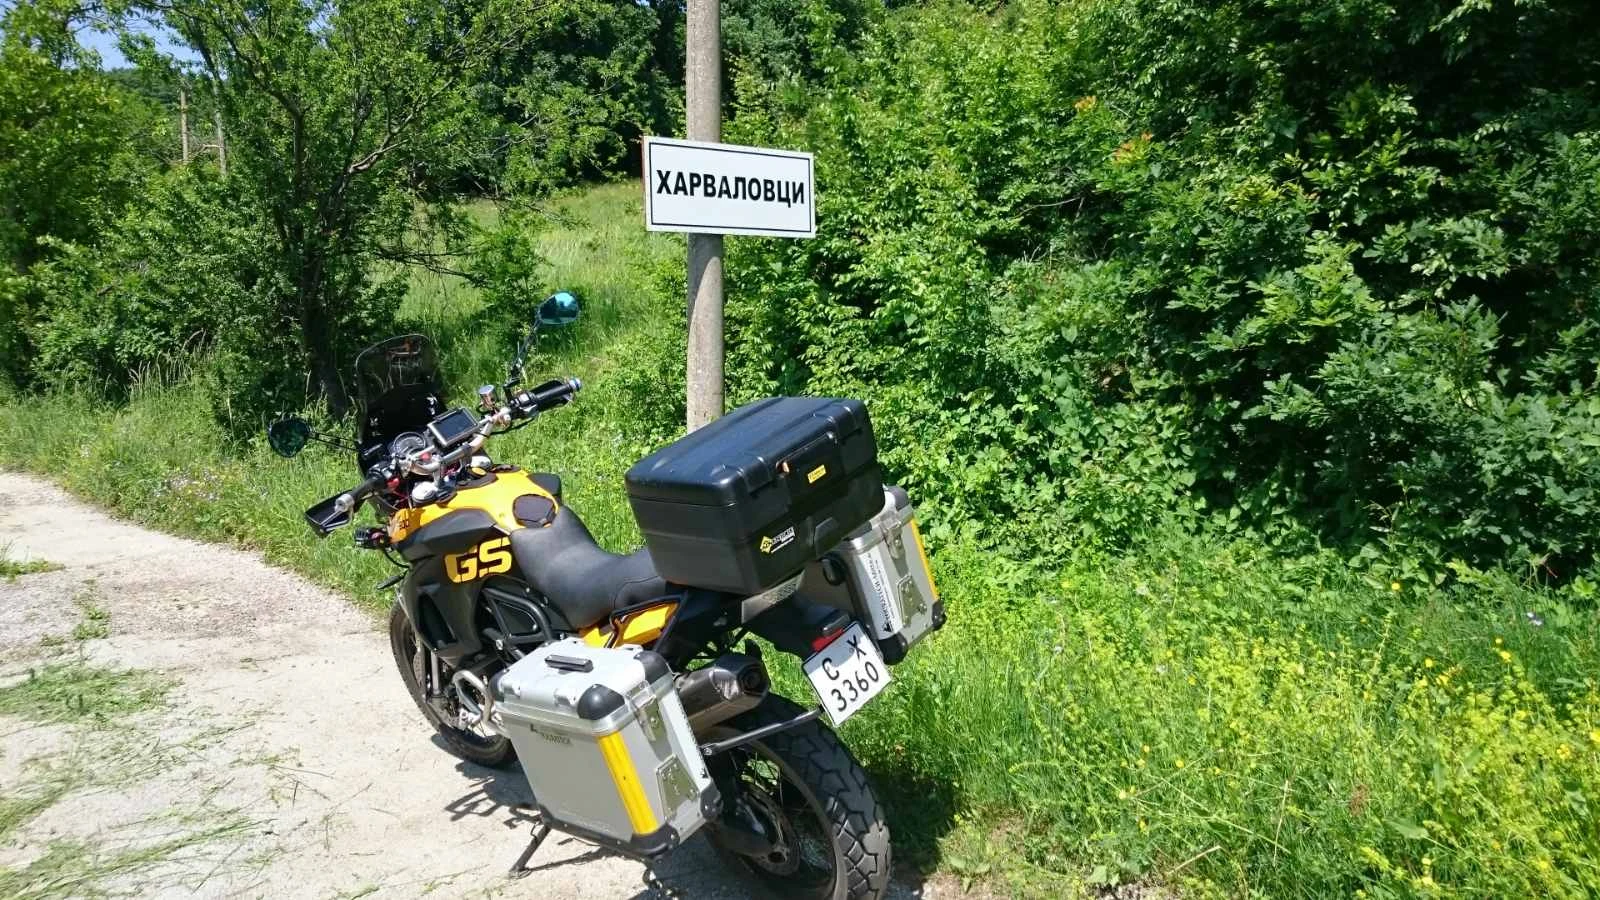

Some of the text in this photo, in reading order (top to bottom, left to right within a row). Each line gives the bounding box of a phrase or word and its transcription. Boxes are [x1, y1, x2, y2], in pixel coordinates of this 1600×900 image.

[656, 169, 805, 208] ХАРВАЛОВЦИ
[445, 537, 512, 584] GS
[821, 635, 867, 681] C X
[831, 661, 879, 712] 3360
